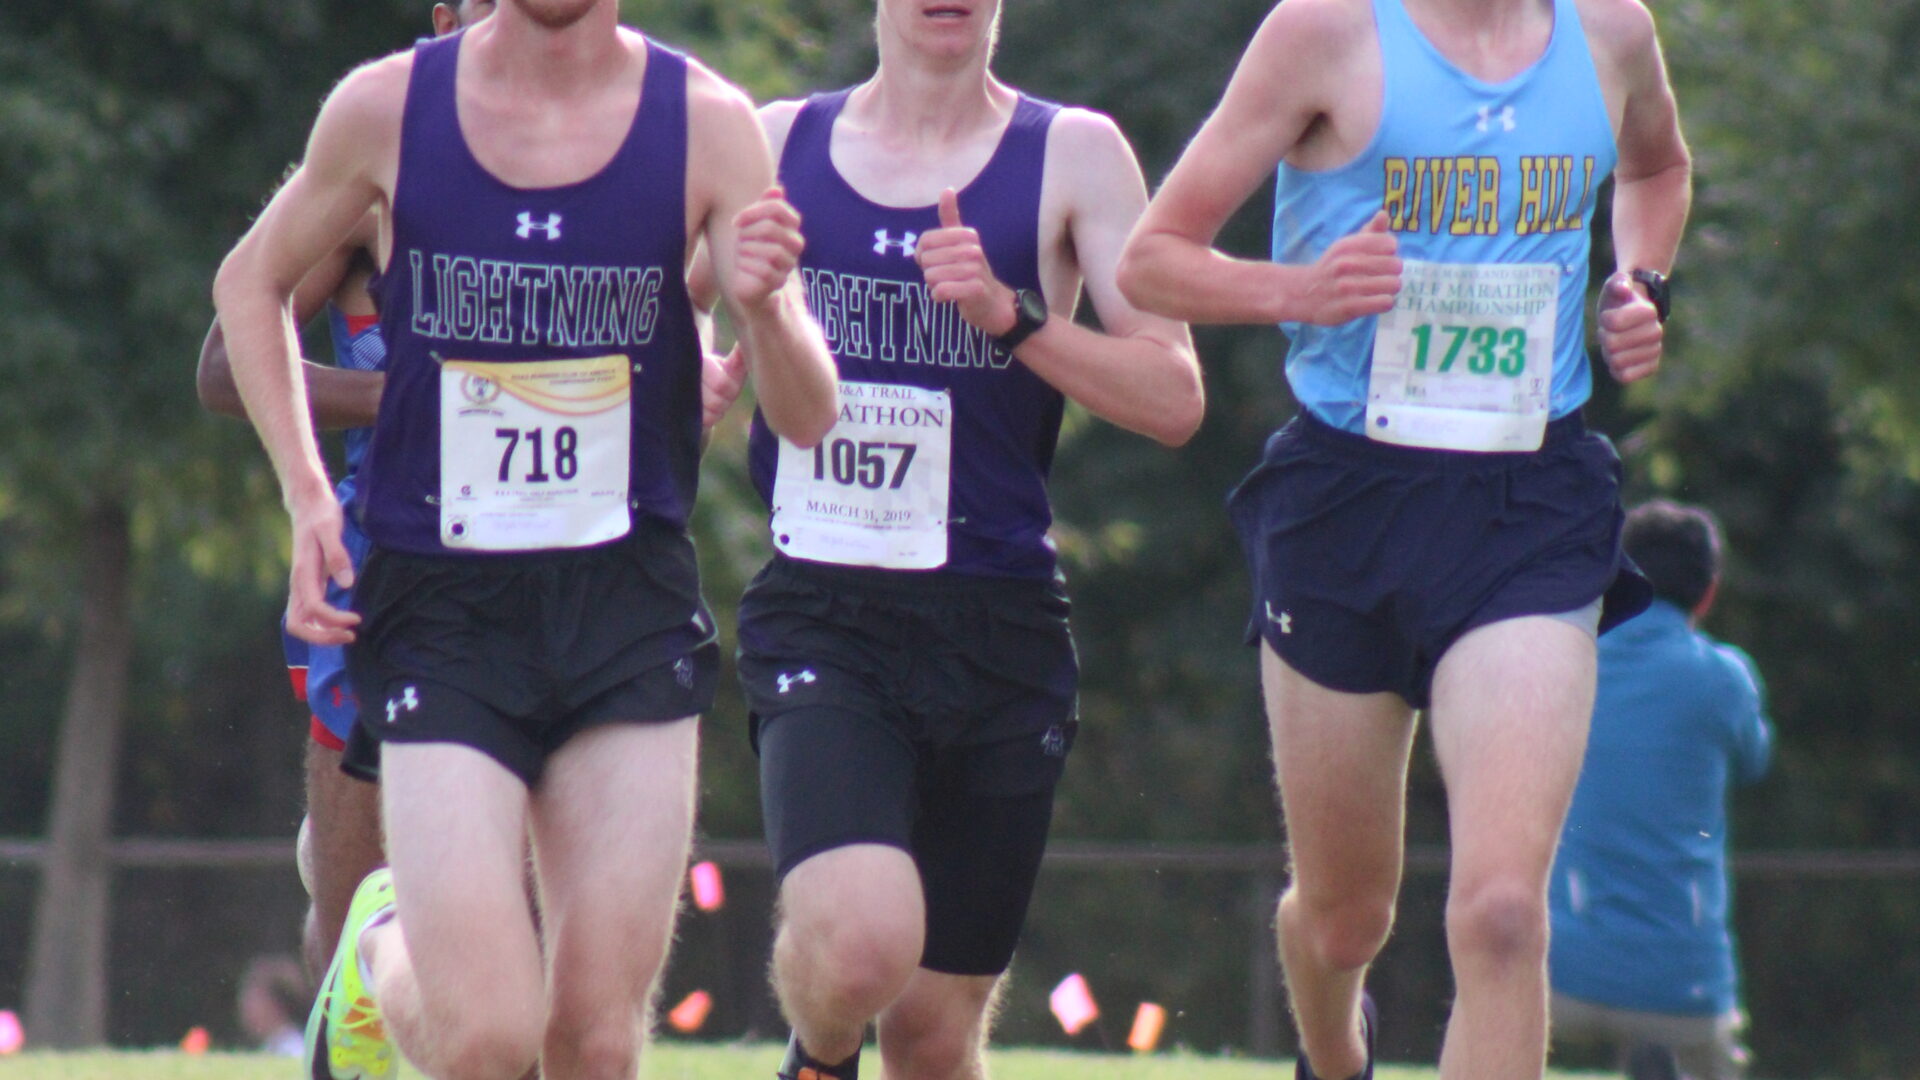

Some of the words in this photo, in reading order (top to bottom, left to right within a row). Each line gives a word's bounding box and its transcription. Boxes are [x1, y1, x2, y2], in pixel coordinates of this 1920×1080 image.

[1384, 156, 1500, 236] RIVER
[409, 249, 664, 347] LIGHTNING
[1402, 280, 1440, 294] ALF
[1446, 281, 1554, 299] MARATHON
[1411, 323, 1527, 378] 1733
[839, 403, 945, 428] ATHON
[869, 386, 917, 401] TRAIL
[495, 426, 577, 482] 718
[814, 438, 917, 490] 1057
[806, 500, 859, 518] MARCH
[864, 509, 879, 524] 31,
[883, 510, 912, 522] 2019
